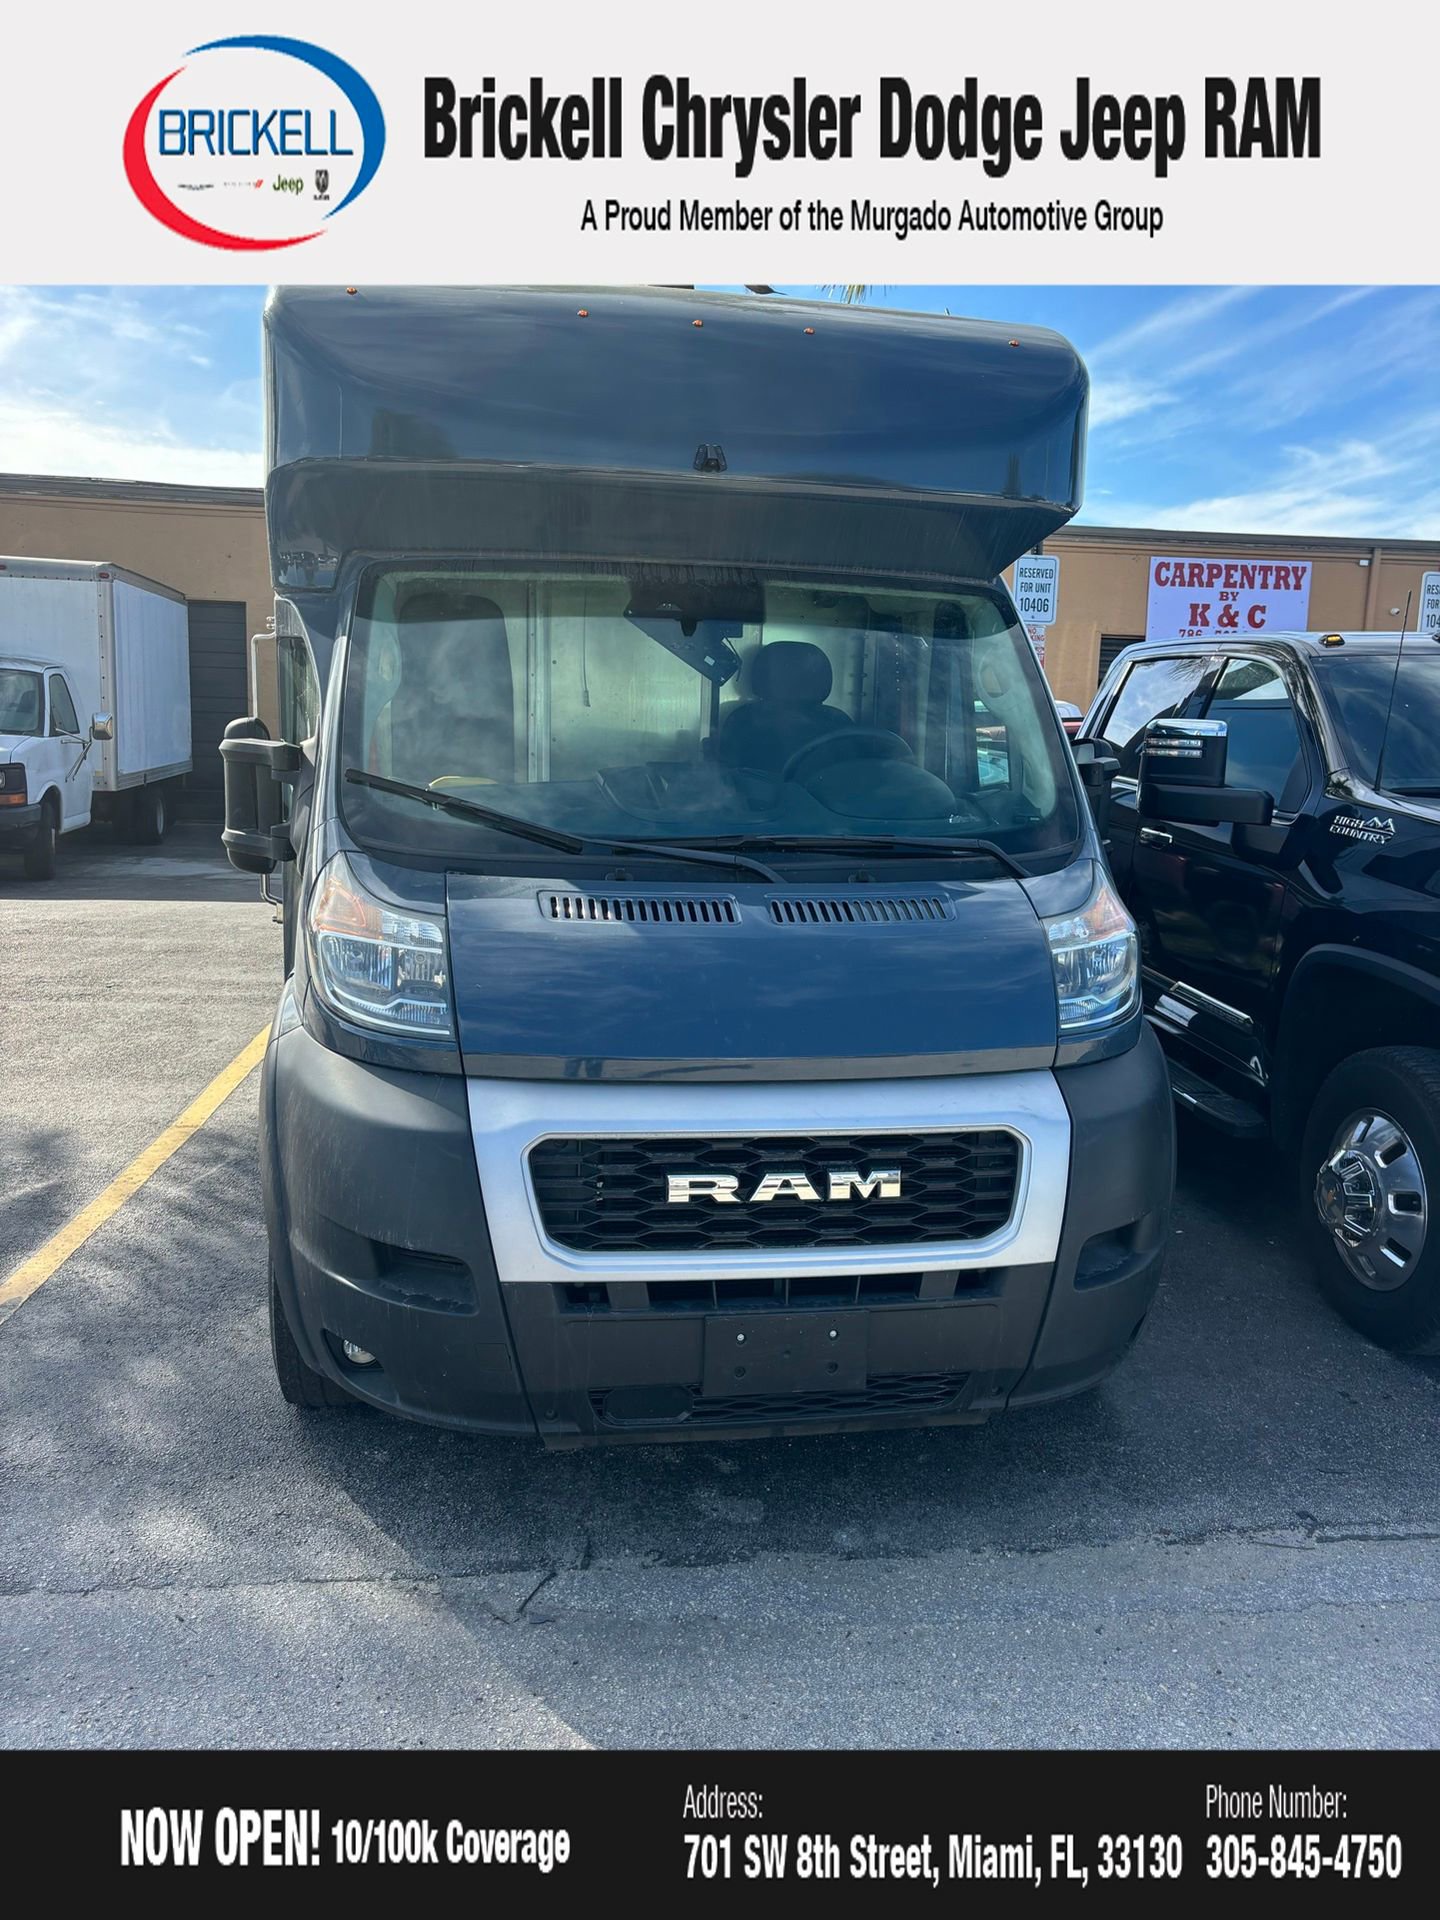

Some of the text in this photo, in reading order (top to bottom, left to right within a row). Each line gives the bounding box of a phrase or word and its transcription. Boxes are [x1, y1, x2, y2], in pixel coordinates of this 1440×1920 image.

[1019, 567, 1054, 579] RESERVED
[1154, 561, 1307, 591] CARPENTRY
[1020, 582, 1052, 593] FOR UNIT
[1426, 584, 1440, 595] RES
[1219, 591, 1239, 601] BY
[1020, 597, 1050, 613] 10406
[1188, 603, 1266, 629] K & C
[1334, 815, 1365, 829] HIGH
[1329, 824, 1392, 845] COUNTRY
[667, 1170, 901, 1203] RAM
